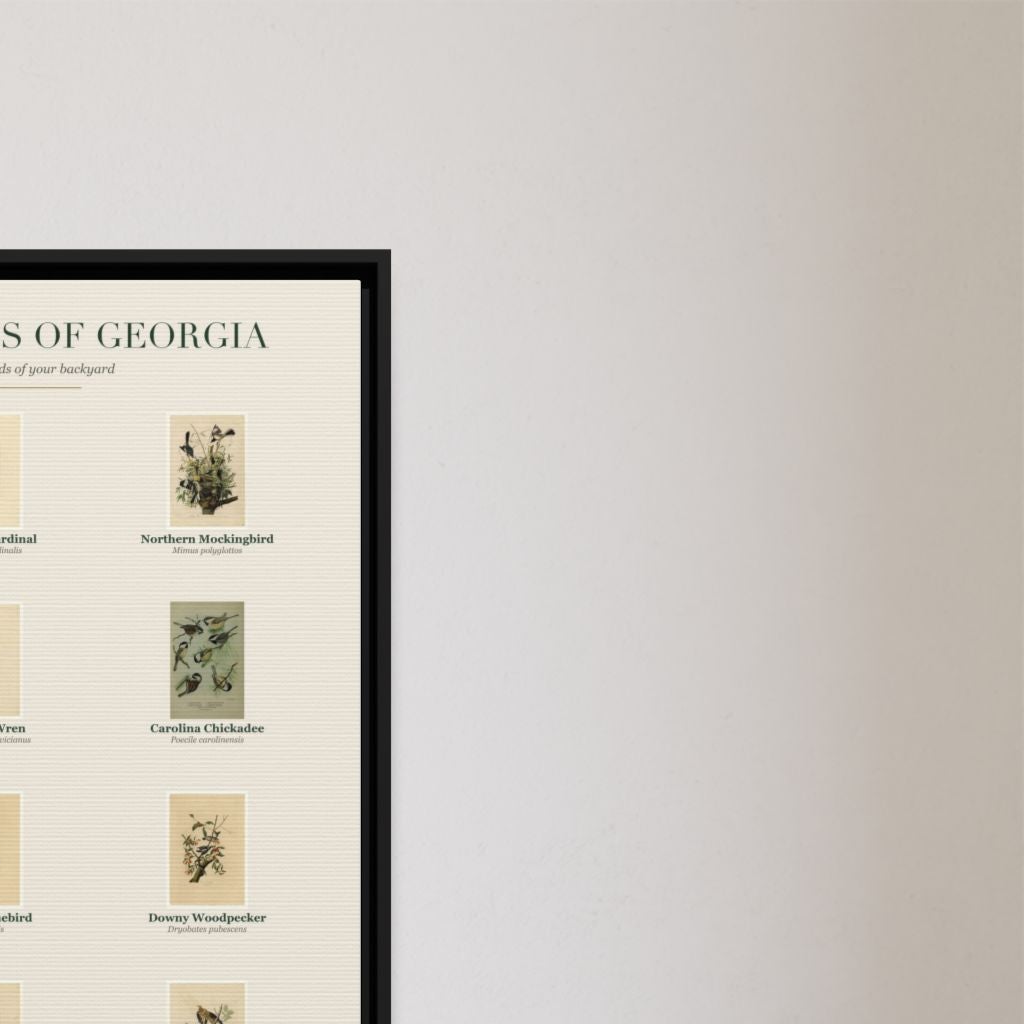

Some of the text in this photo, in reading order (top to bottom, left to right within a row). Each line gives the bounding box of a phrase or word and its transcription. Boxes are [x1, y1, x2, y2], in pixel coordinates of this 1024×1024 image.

[35, 322, 84, 348] OF
[97, 322, 269, 348] GEORGIA
[14, 363, 28, 376] of
[29, 366, 57, 376] your
[60, 362, 116, 377] backyard
[140, 534, 274, 546] Northern Mockingbird
[150, 723, 264, 733] Carolina Chickadee
[149, 912, 267, 925] Downy Woodpecker
